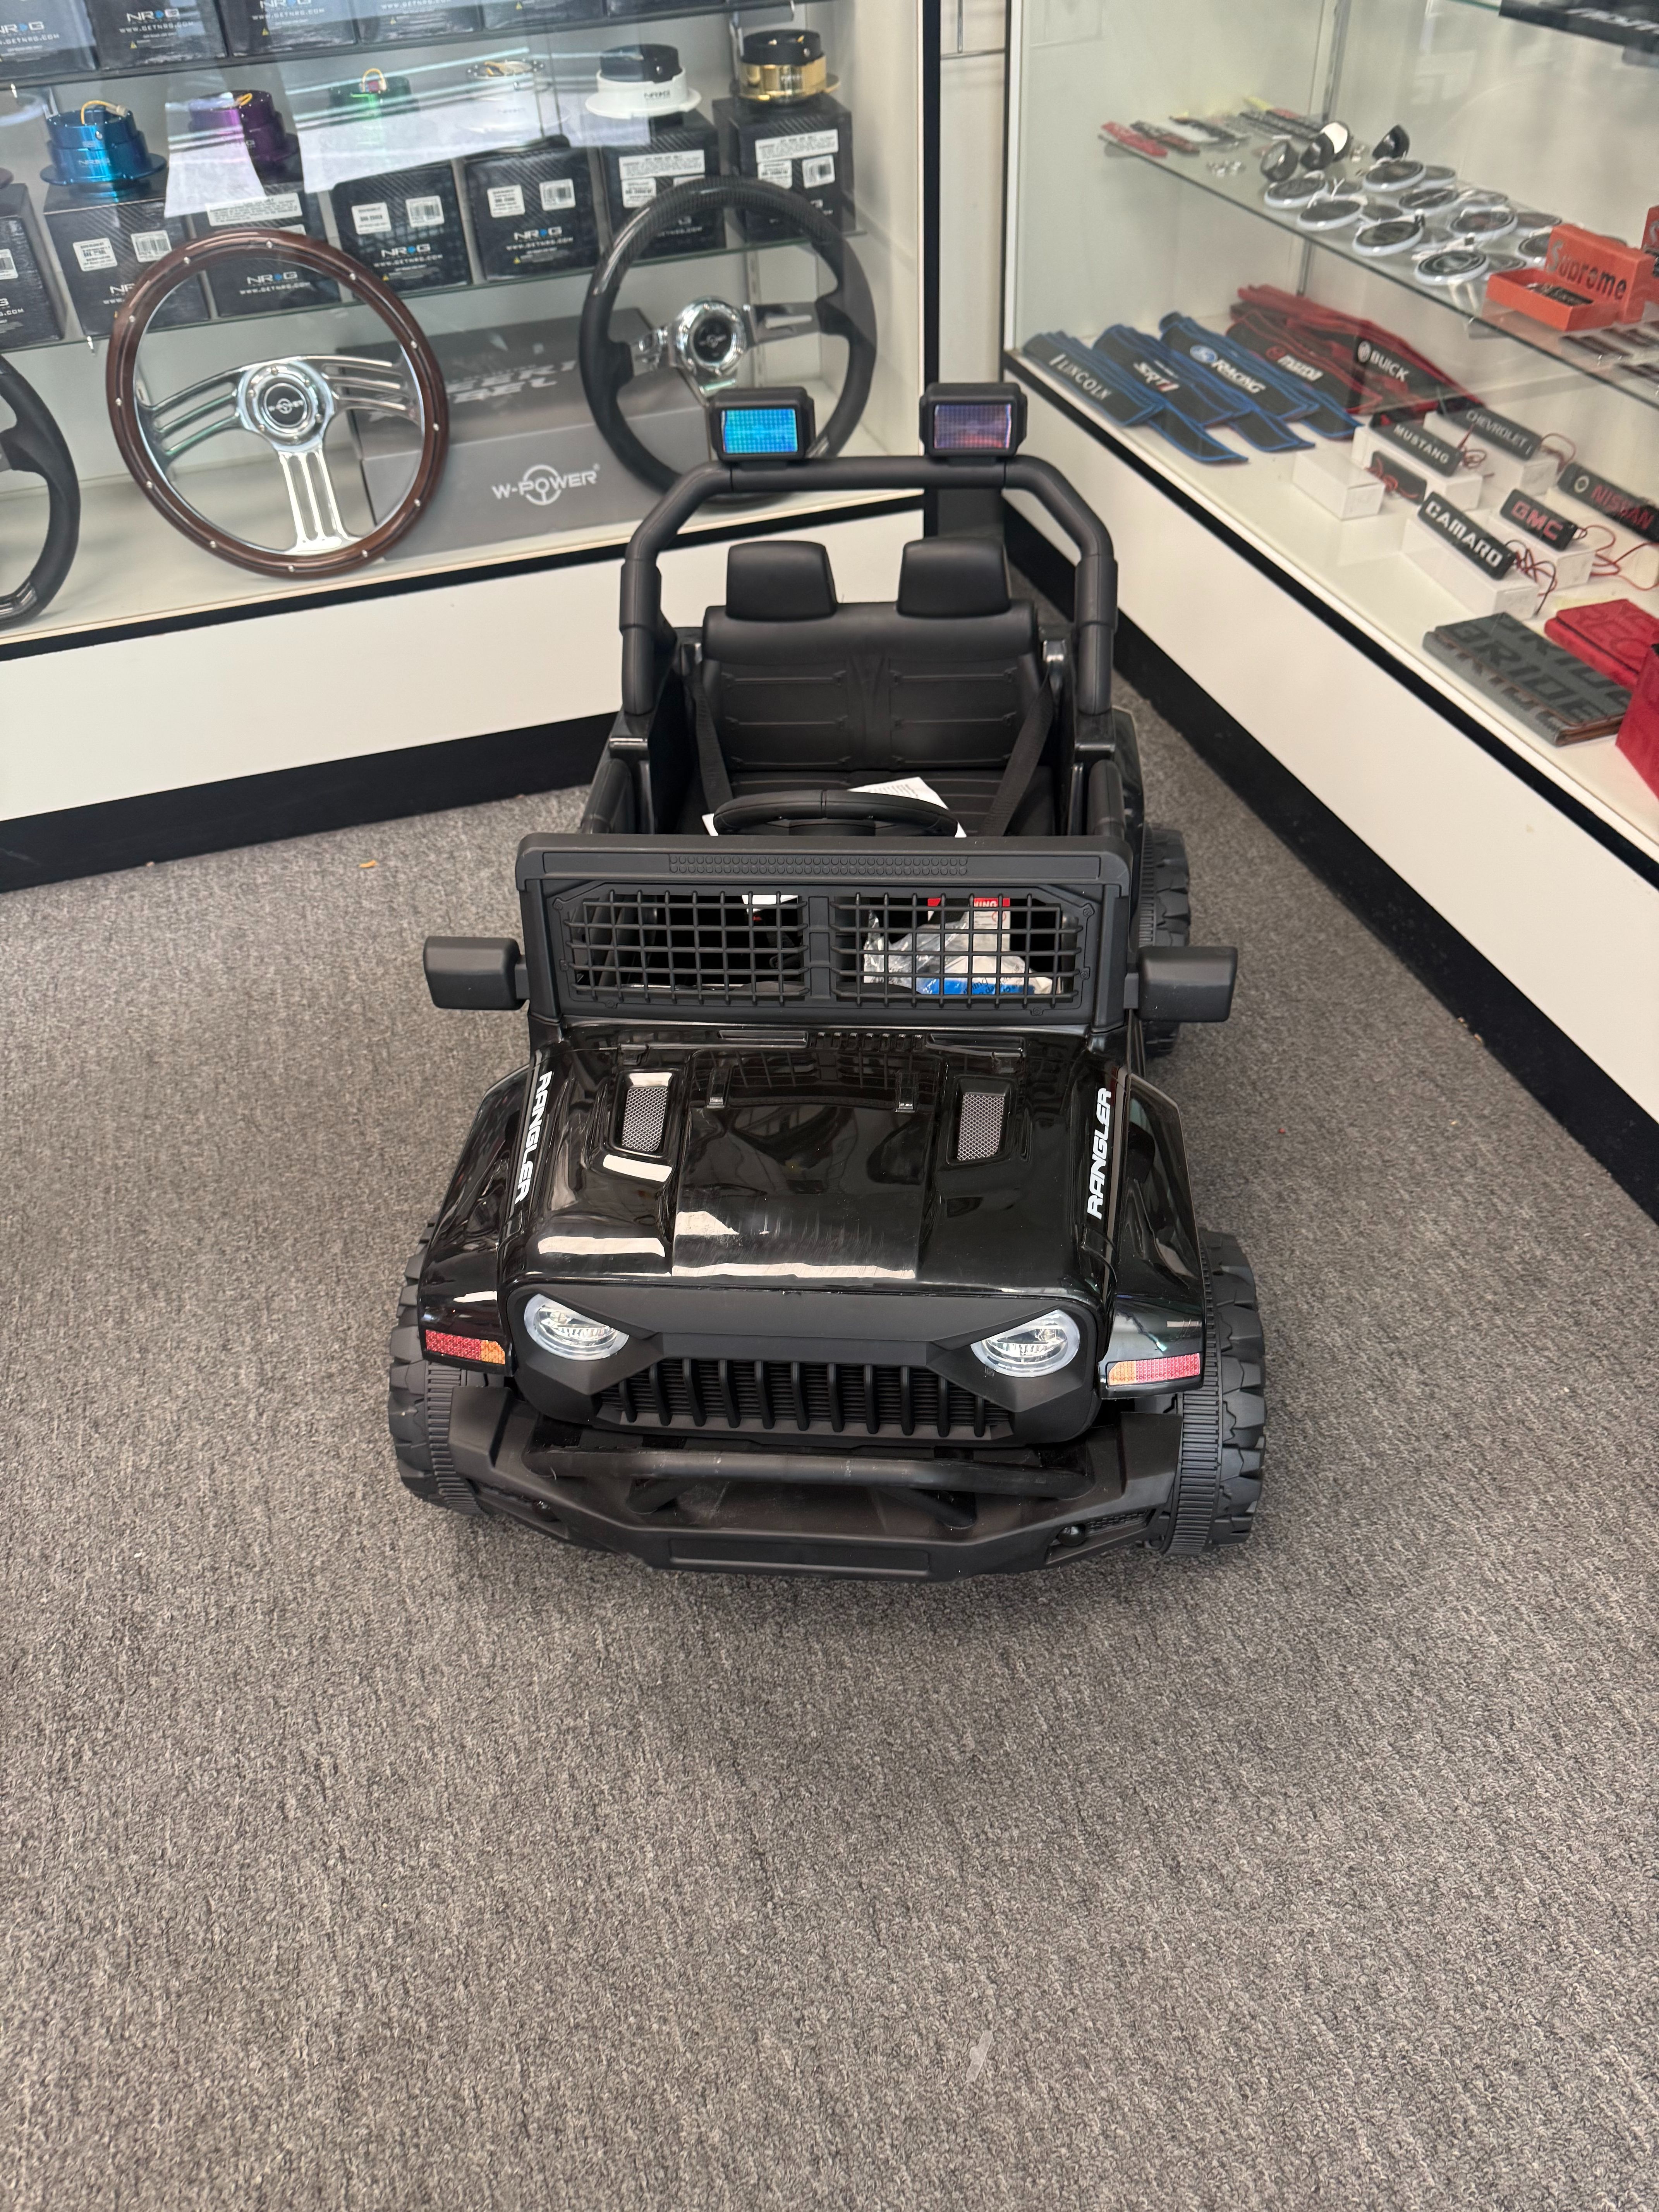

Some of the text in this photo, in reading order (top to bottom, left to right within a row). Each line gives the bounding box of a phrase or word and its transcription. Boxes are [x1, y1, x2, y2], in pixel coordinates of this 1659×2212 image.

[126, 8, 180, 22] NRG
[247, 271, 298, 285] NRG
[1369, 349, 1410, 382] BUICK
[1394, 424, 1450, 464] MUSTANG
[1425, 501, 1503, 568] CAMARO
[1511, 501, 1564, 541] GMC
[514, 1071, 553, 1205] RANGLER
[1087, 1087, 1111, 1220] RANGLER
